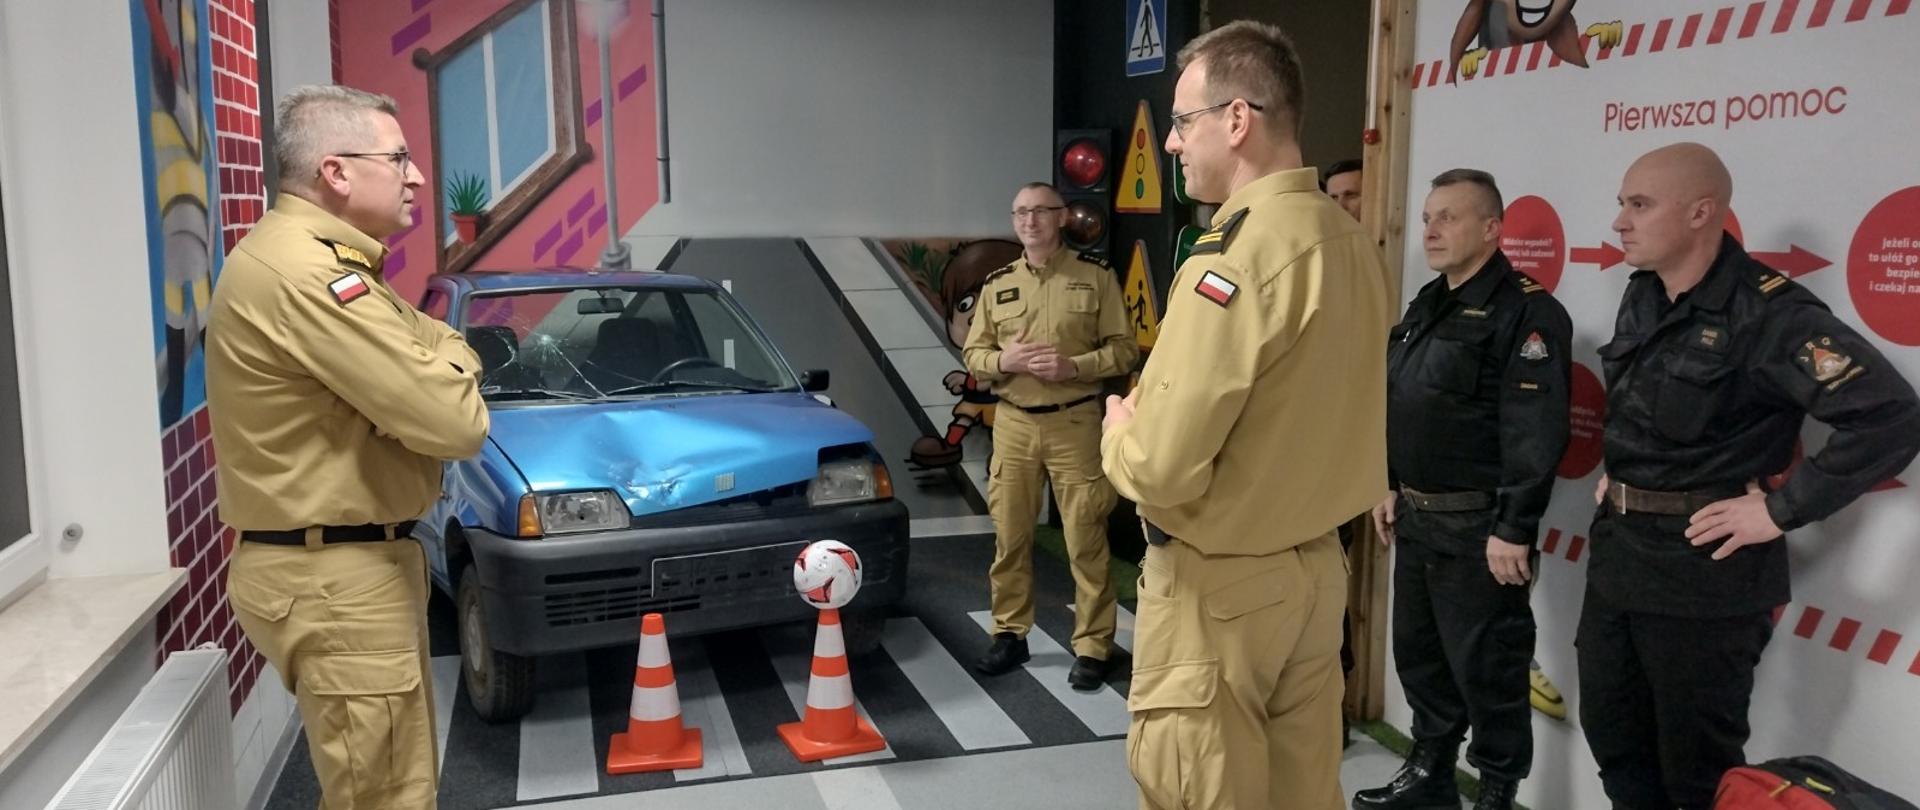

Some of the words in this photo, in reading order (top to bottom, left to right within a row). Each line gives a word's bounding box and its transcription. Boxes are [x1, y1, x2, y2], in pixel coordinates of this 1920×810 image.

[1603, 99, 1716, 132] Pierwsza
[1725, 86, 1847, 129] pomoc
[1869, 253, 1879, 262] to
[1905, 255, 1918, 265] go
[1874, 280, 1906, 295] czekaj
